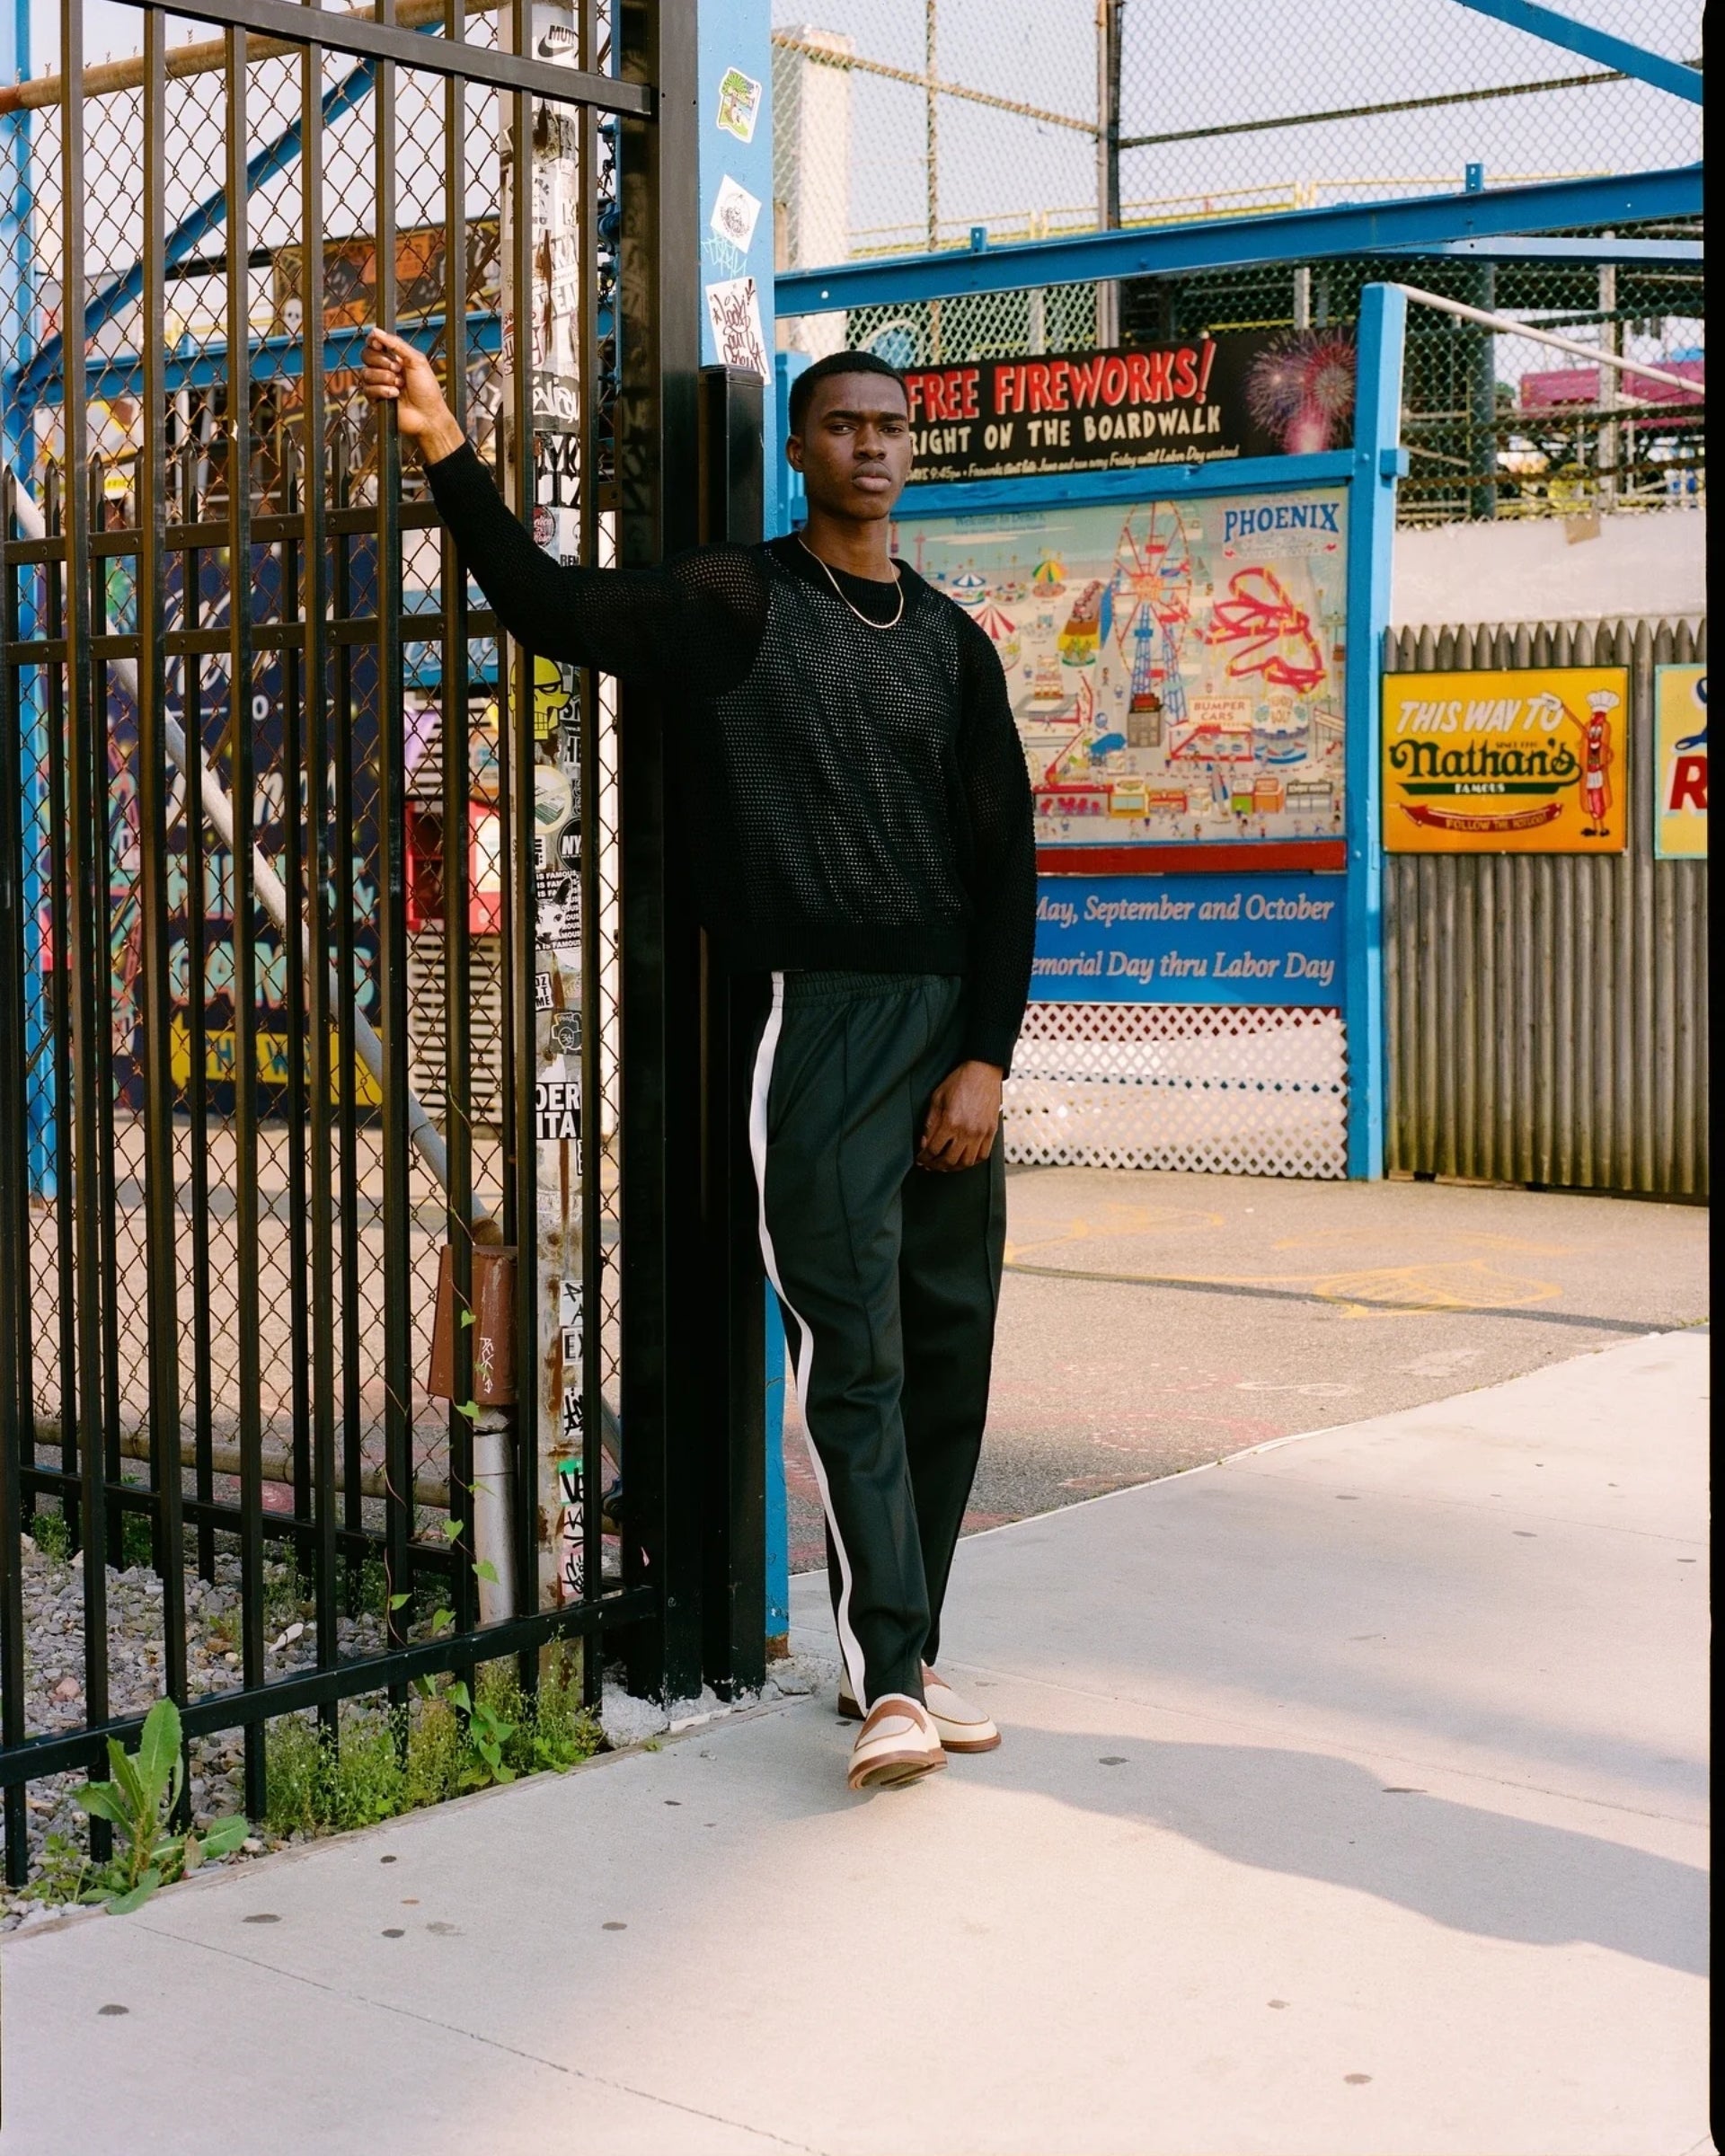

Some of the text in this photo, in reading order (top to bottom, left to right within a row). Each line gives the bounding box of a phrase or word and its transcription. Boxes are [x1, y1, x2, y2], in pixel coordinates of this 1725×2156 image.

[905, 339, 1216, 422] FREE FIREWORKS!
[984, 422, 1013, 450] ON
[1027, 419, 1071, 446] THE
[1084, 405, 1221, 442] BOARDWALK
[1224, 502, 1340, 543] PHOENIX
[1194, 702, 1245, 711] BUMPER
[1201, 712, 1234, 721] CARS
[1396, 694, 1564, 733] THIS WAY TO
[1389, 738, 1582, 777] Nathan's
[1455, 783, 1505, 794] FAMOUS
[1446, 818, 1491, 831] FOLLOW
[1084, 895, 1194, 928] September
[1199, 894, 1240, 921] and
[1245, 893, 1335, 922] October
[1031, 951, 1335, 986] emorial Day thru Labor Day
